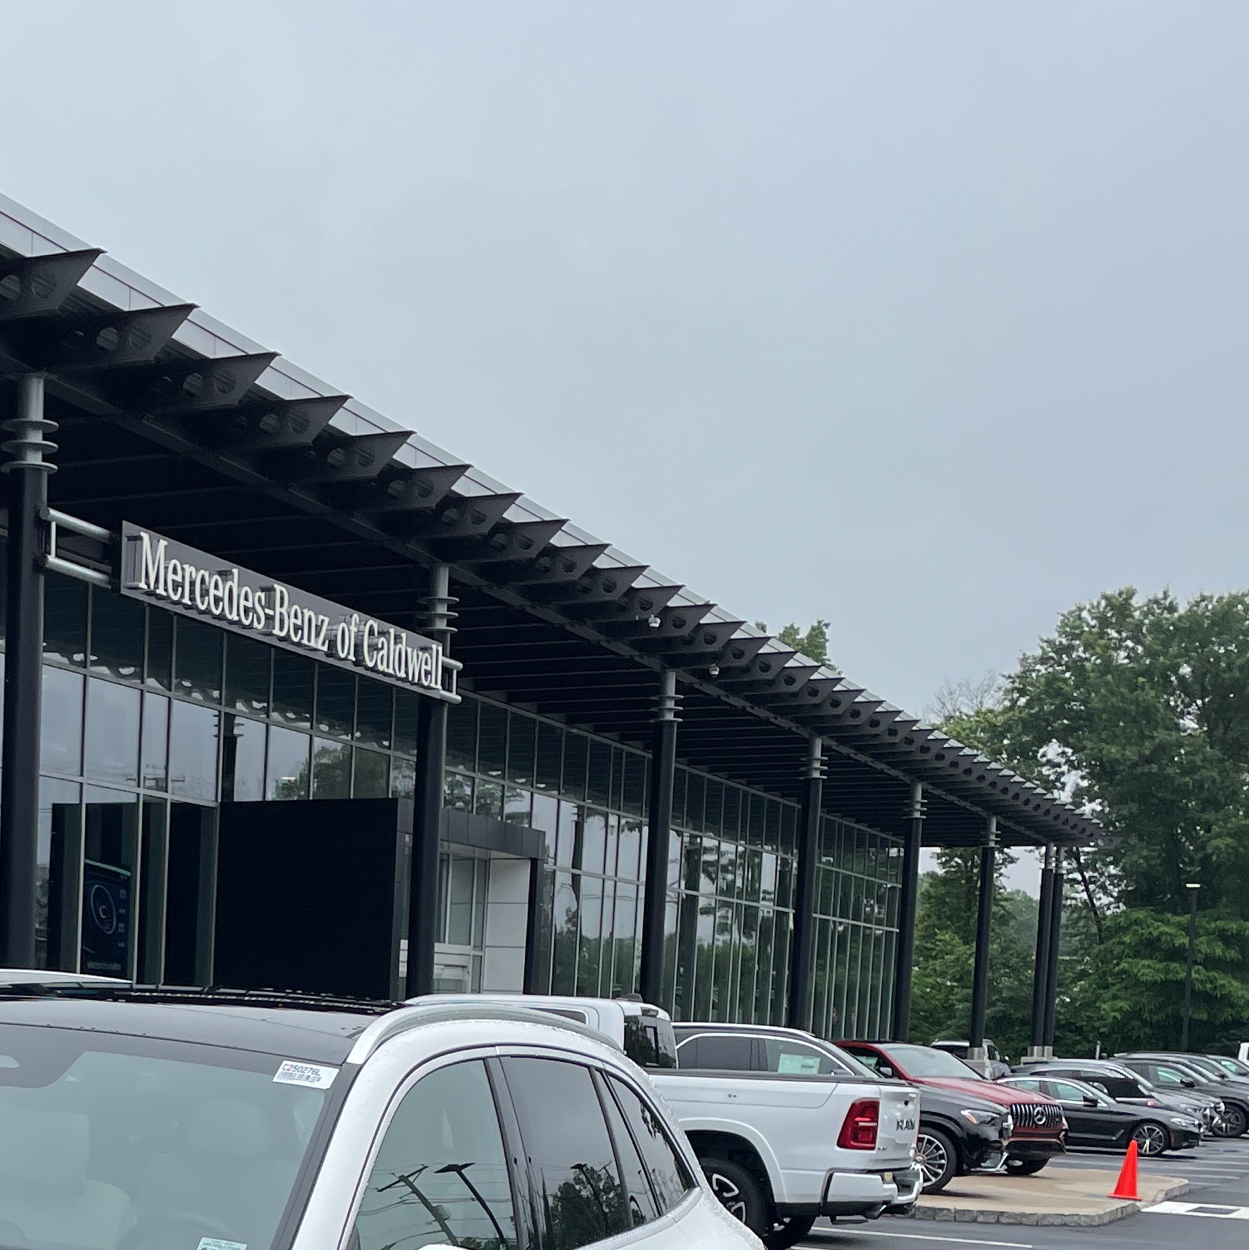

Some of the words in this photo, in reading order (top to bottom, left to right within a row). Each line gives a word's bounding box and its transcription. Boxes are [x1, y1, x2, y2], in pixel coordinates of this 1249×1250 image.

[139, 531, 330, 652] Mercedes-Benz
[336, 613, 361, 662] of
[363, 619, 444, 691] Caldwell
